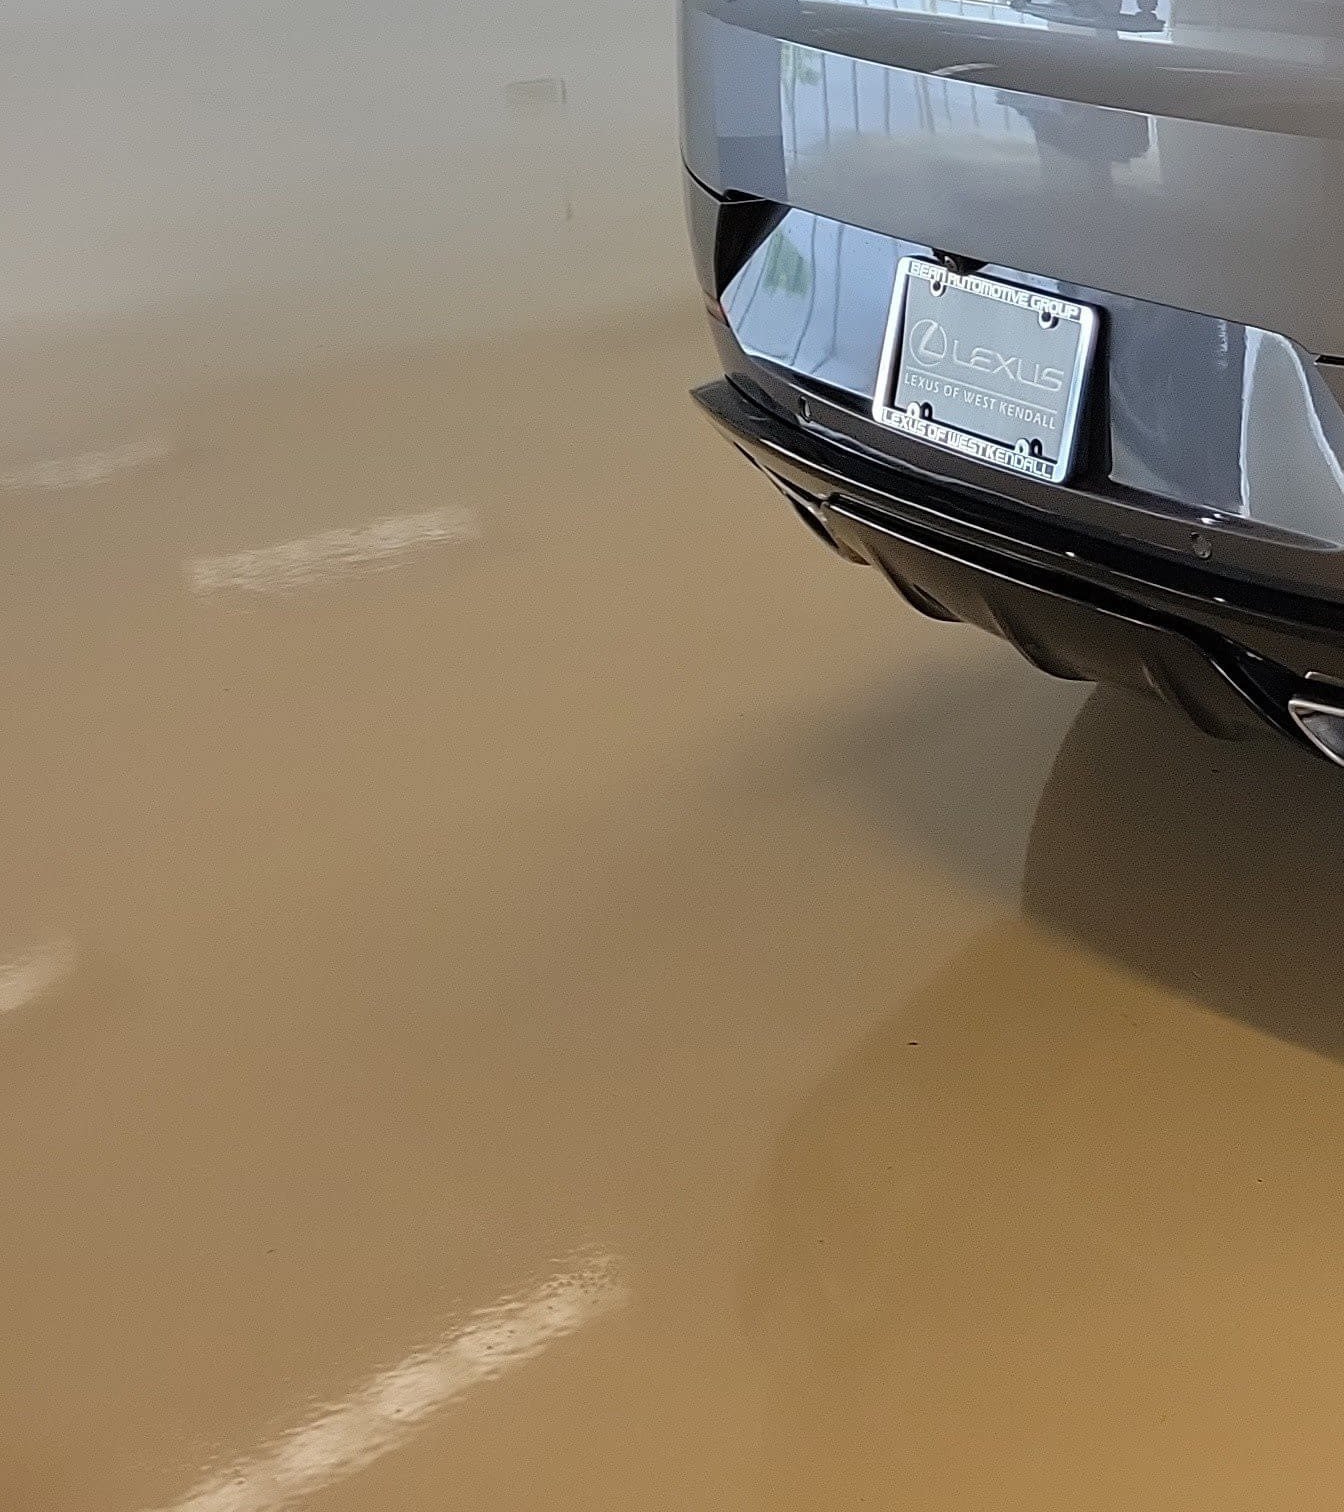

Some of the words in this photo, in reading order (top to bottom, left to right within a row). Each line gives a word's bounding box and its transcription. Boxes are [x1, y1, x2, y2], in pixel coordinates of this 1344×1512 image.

[909, 260, 946, 283] BEAN
[948, 272, 1030, 307] AUTOMOTIVE
[1030, 295, 1080, 320] GROUP
[952, 340, 1065, 393] LEXUS
[904, 372, 940, 393] LEXUS
[943, 381, 960, 399] OF
[963, 390, 996, 411] WEST
[998, 400, 1056, 430] KENDALL
[882, 408, 926, 436] LEXUS
[927, 424, 947, 442] OF
[946, 431, 986, 457] WEST
[986, 443, 1051, 479] KENDALL
